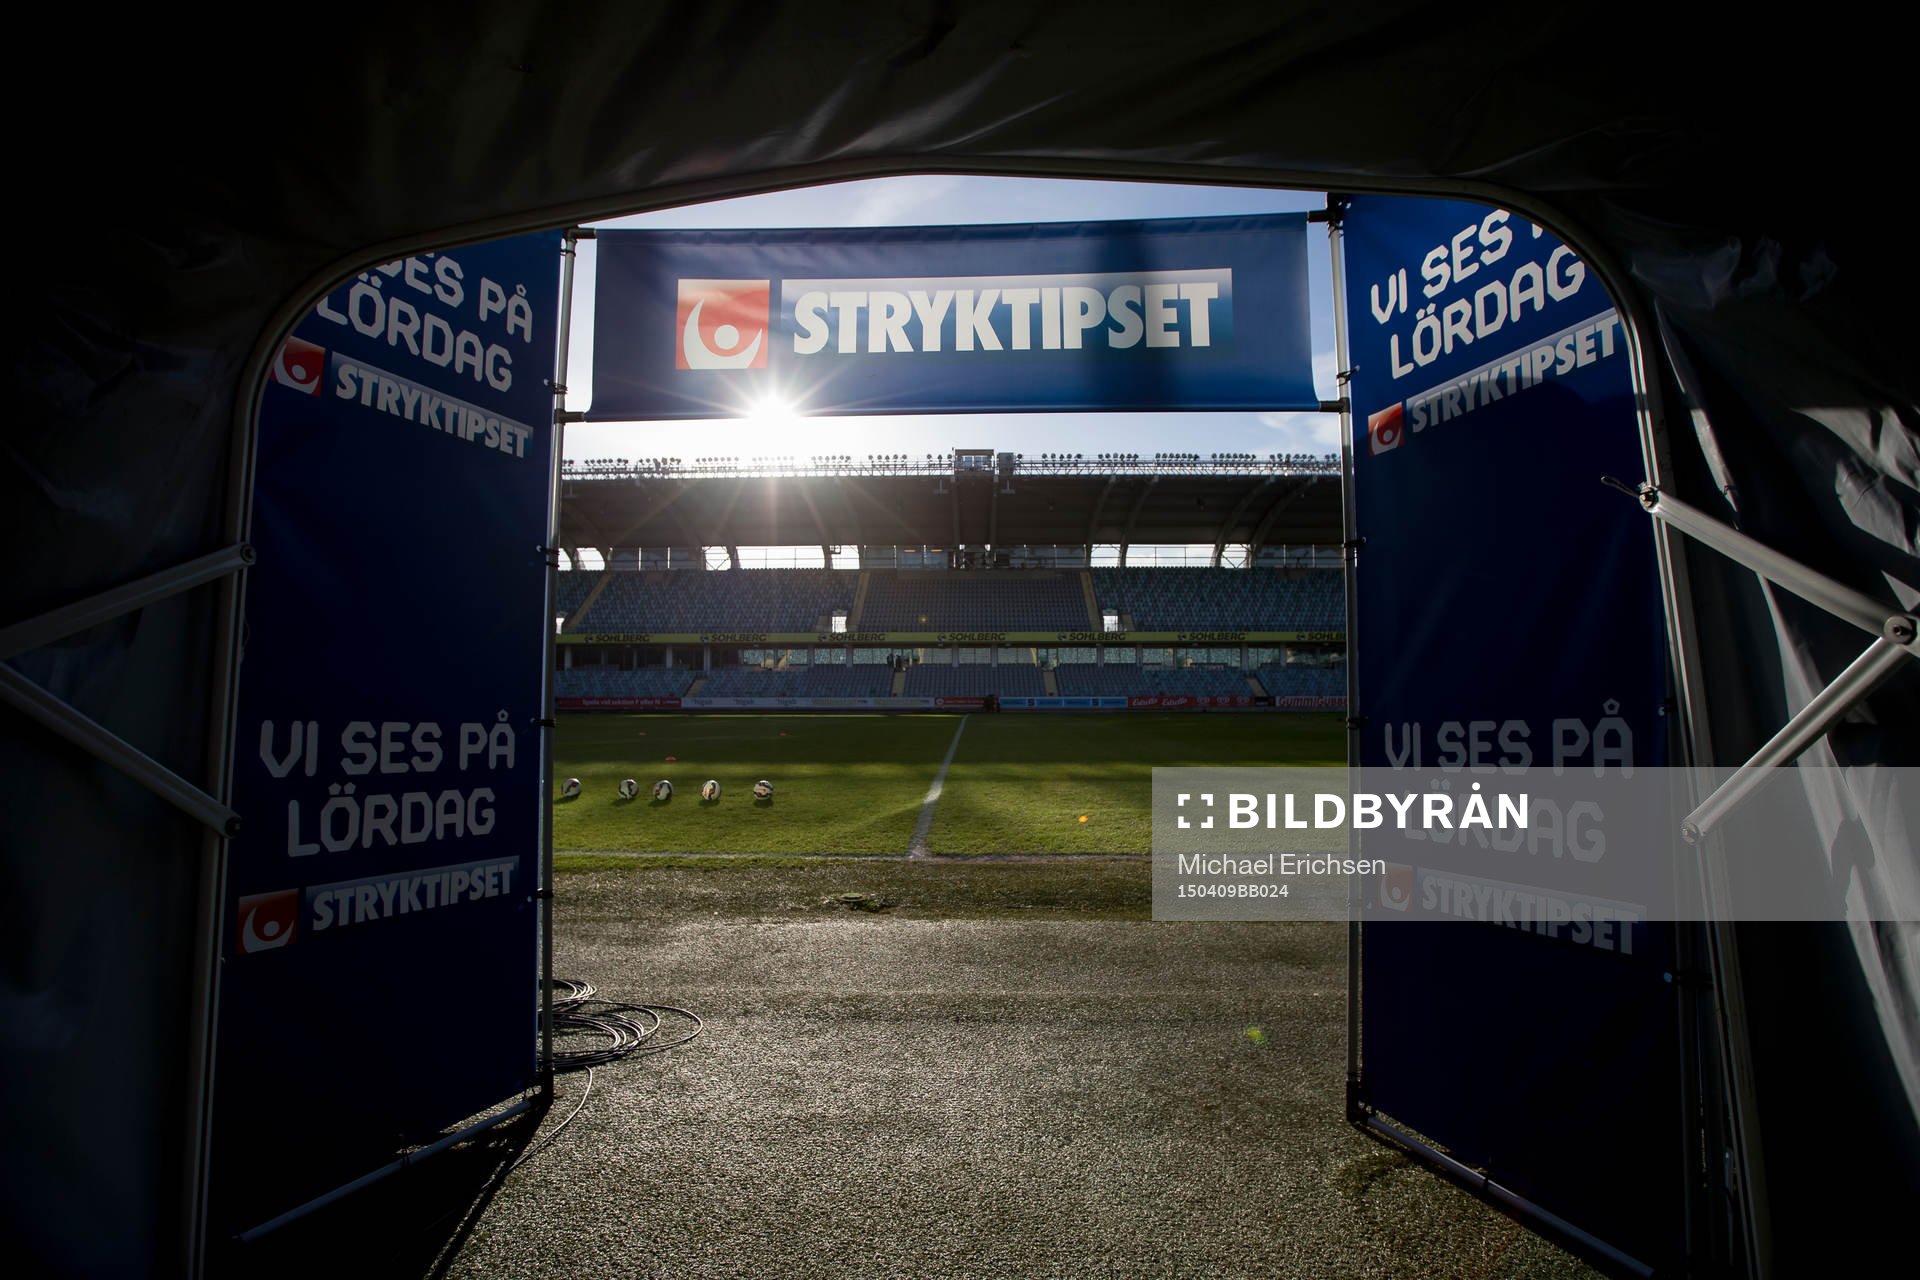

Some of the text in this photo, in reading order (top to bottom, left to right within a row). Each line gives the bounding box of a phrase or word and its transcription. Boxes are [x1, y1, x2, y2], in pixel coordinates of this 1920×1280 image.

[1370, 209, 1513, 324] VI SES
[316, 272, 512, 392] LÖRDAG
[479, 277, 533, 343] PÅ
[793, 283, 1218, 354] STRYKTIPSET
[1390, 244, 1585, 379] LÖRDAG
[336, 363, 529, 458] STRYKTIPSET
[1412, 313, 1618, 433] STRYKTIPSET
[259, 708, 515, 778] VI SES PÅ
[1384, 698, 1634, 779] VI SES PÅ
[287, 782, 495, 857] LÖRDAG
[312, 862, 514, 931] STRYKTIPSET
[1422, 876, 1639, 955] STRYKTIPSET
